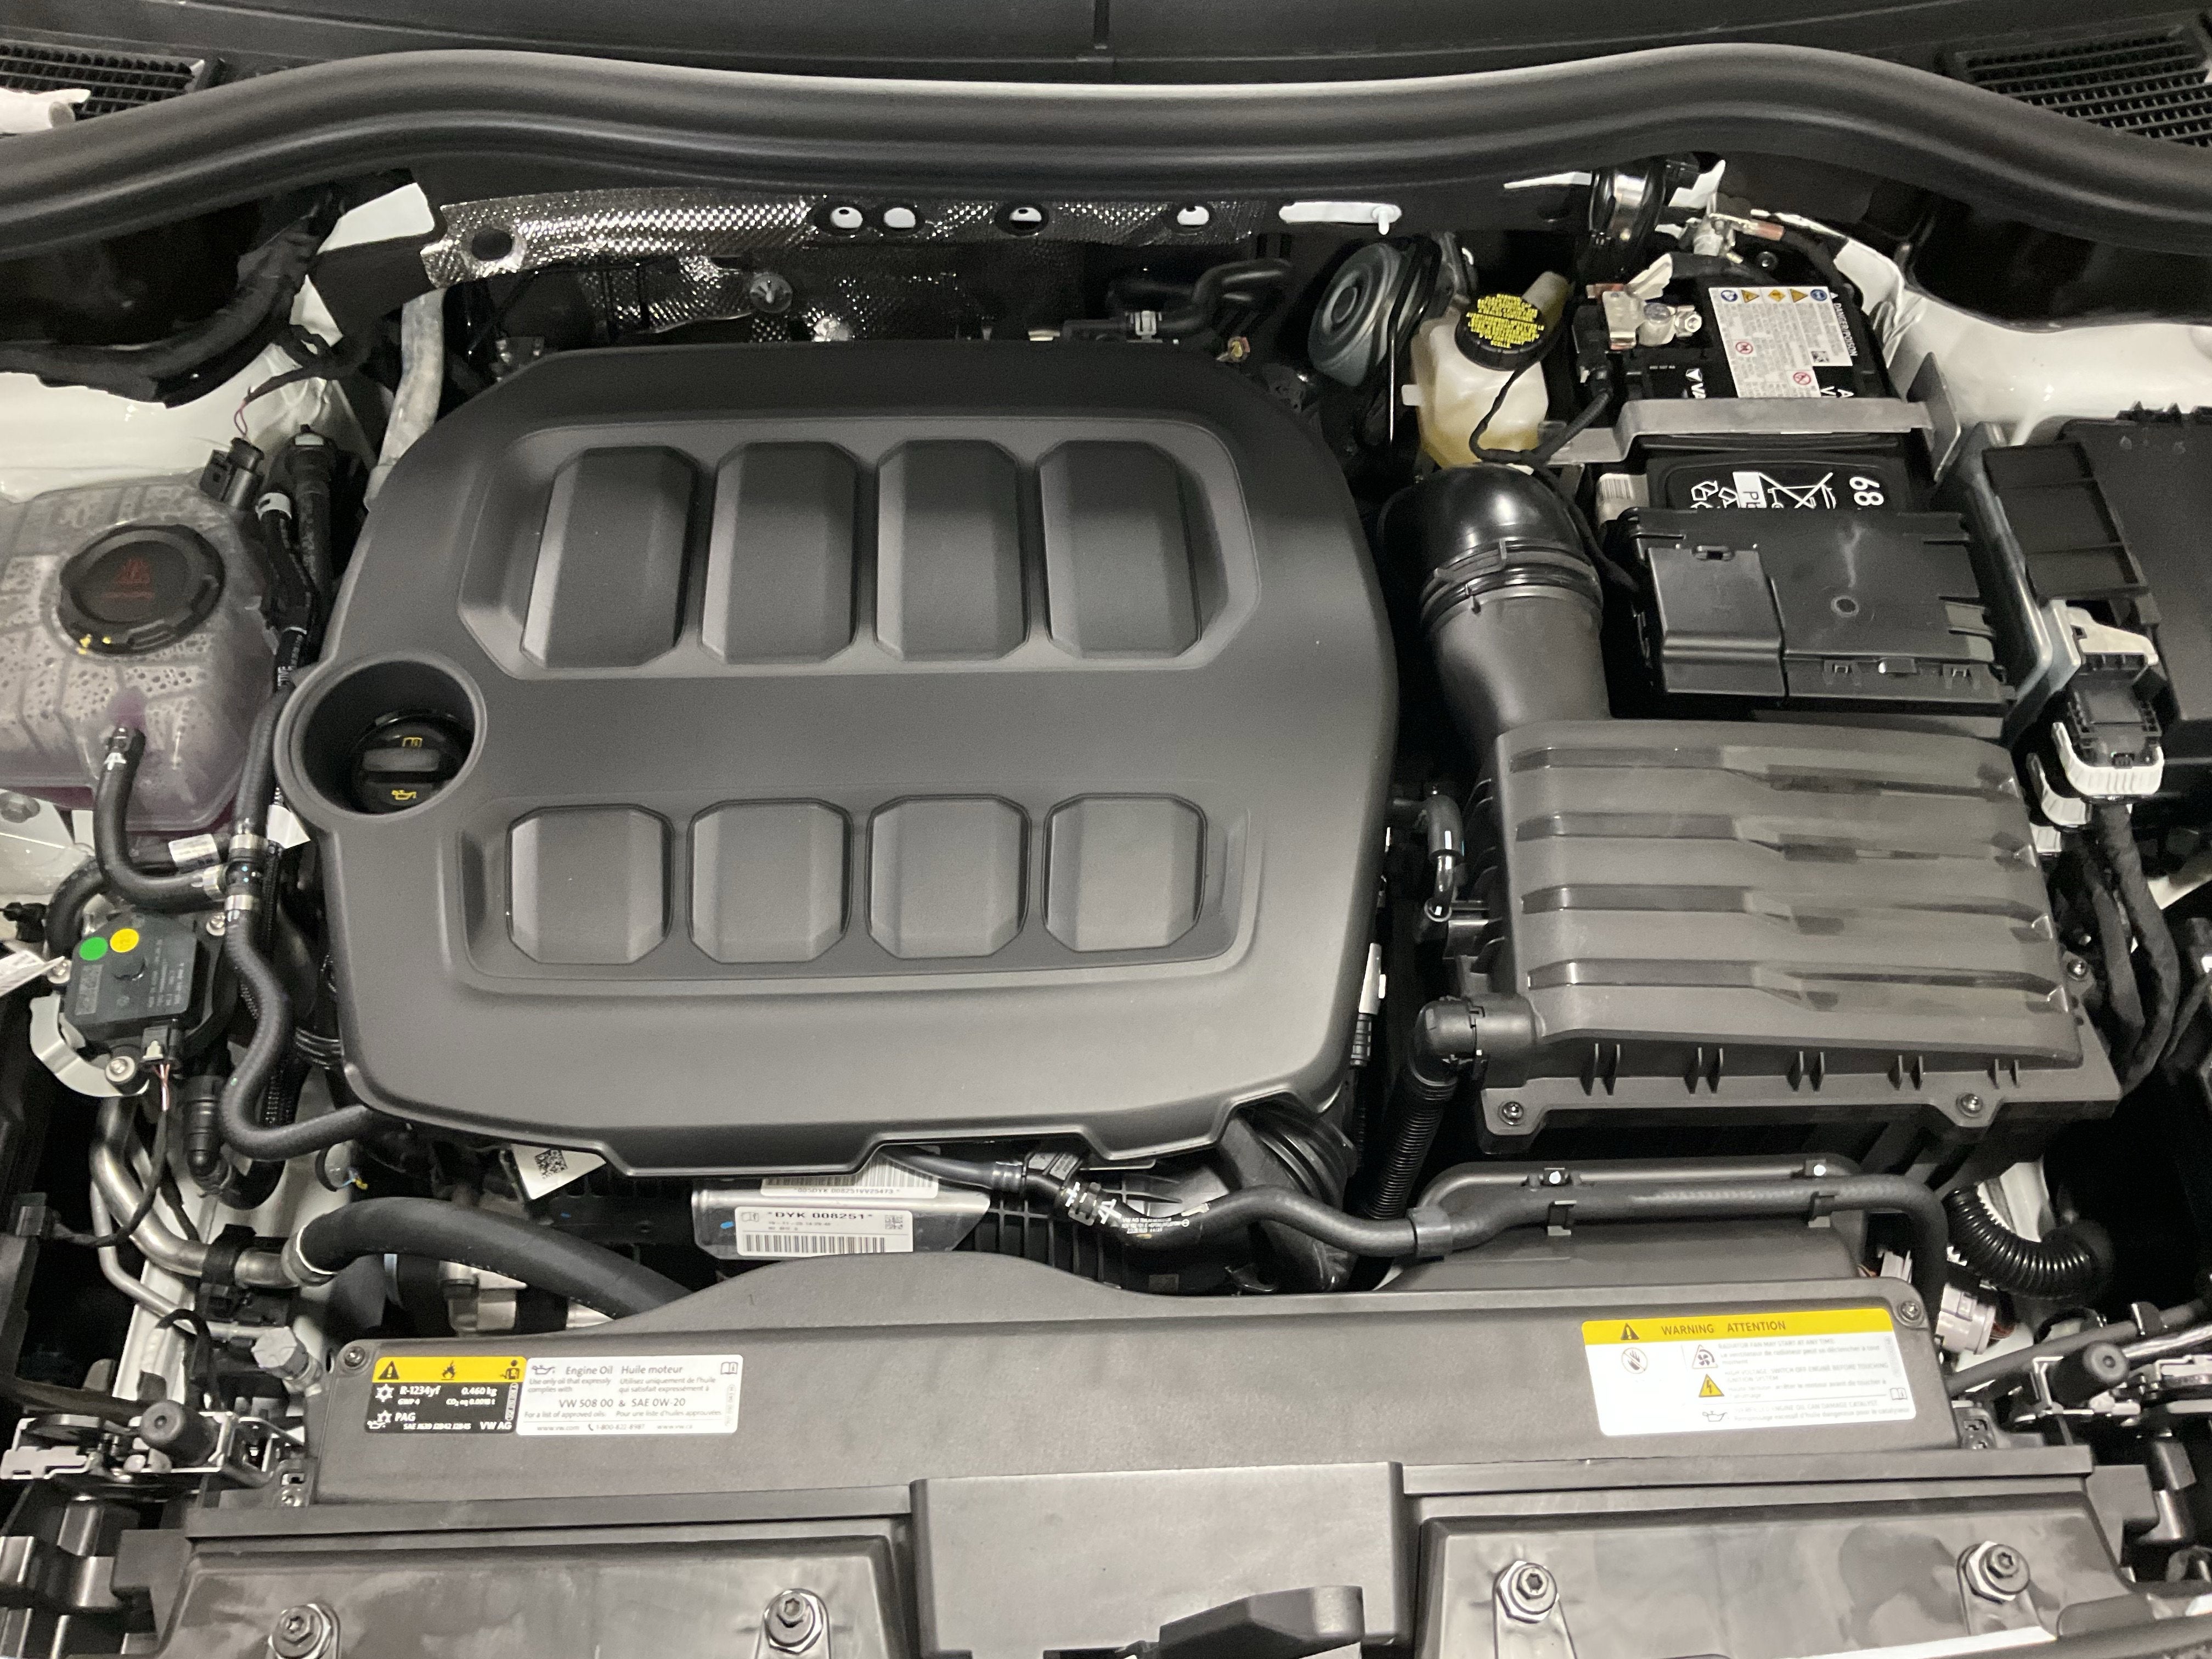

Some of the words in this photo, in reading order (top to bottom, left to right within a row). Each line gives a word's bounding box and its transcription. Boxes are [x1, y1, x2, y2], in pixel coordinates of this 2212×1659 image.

[1835, 302, 1858, 357] DANGER/POISON
[1849, 476, 1884, 506] 68
[1661, 1323, 1714, 1335] WARNING
[1727, 1321, 1787, 1332] ATTENTION
[566, 1366, 597, 1377] Engine
[599, 1365, 613, 1374] Oil
[621, 1365, 646, 1374] Huile
[648, 1365, 683, 1374] moteur
[543, 1378, 557, 1386] only
[582, 1378, 611, 1386] expressly
[645, 1377, 685, 1385] uniquement
[399, 1385, 441, 1397] R-1234yf
[461, 1387, 486, 1395] 0.460
[487, 1386, 498, 1397] kg
[619, 1386, 629, 1394] qui
[559, 1399, 577, 1408] VW
[579, 1399, 597, 1408] 508
[600, 1399, 613, 1407] 00
[631, 1398, 650, 1407] SAE
[652, 1398, 686, 1407] 0W-20
[394, 1412, 416, 1422] PAG
[561, 1410, 592, 1419] approved
[479, 1421, 497, 1430] VW
[496, 1421, 512, 1430] AG
